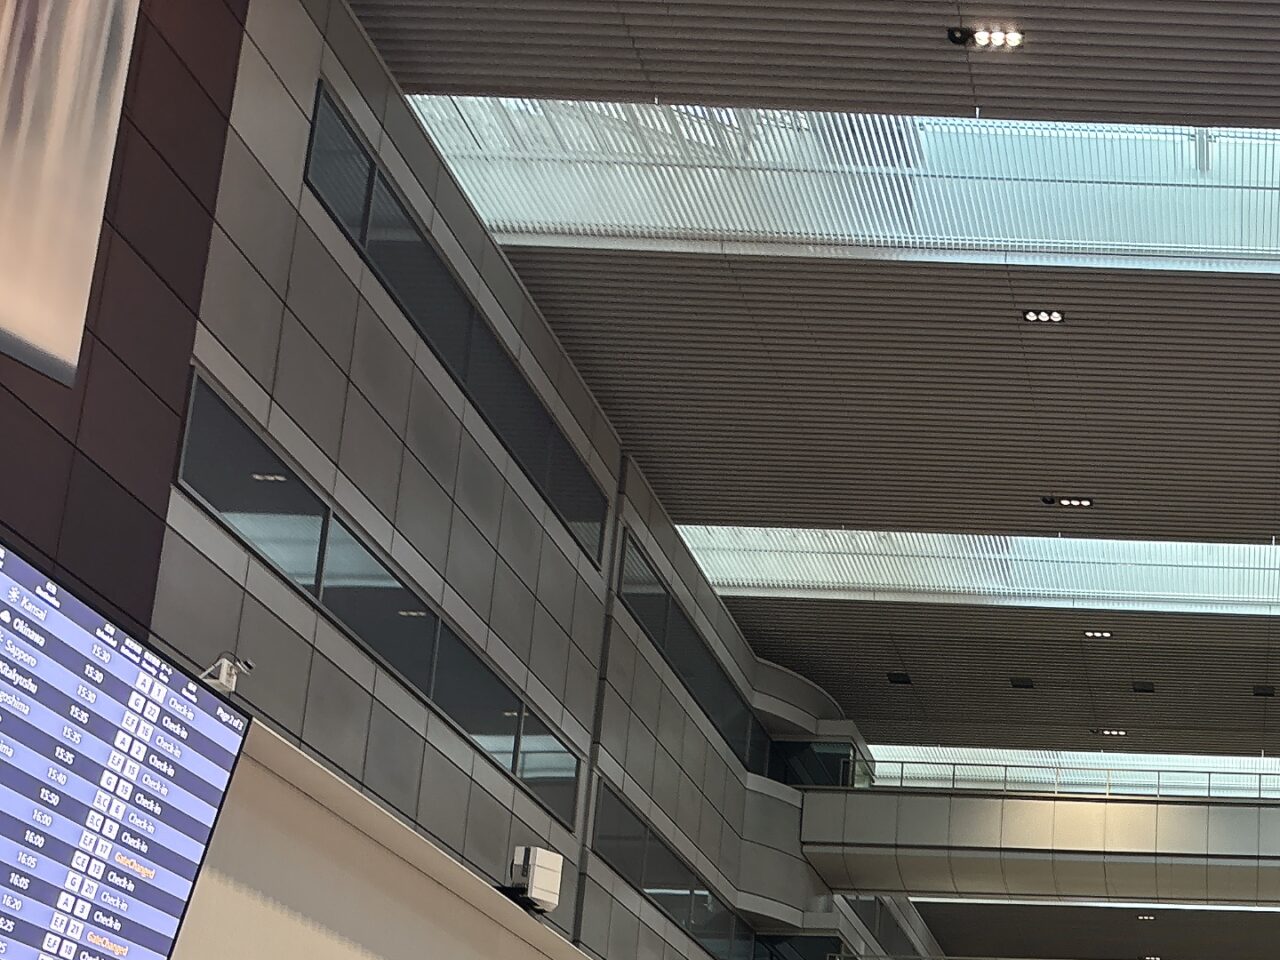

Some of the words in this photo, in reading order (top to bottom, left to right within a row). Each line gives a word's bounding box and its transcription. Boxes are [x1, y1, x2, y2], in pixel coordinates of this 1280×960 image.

[21, 596, 47, 620] Kansai
[169, 698, 194, 720] Check-in
[14, 619, 45, 647] Okinawa
[163, 717, 187, 738] Check-in
[5, 640, 37, 667] Sapporo
[156, 736, 181, 758] Check-in
[150, 755, 174, 776] Check-in
[143, 774, 168, 795] Check-in
[136, 794, 161, 814] Check-in
[129, 813, 154, 833] Check-in
[122, 832, 148, 852] Check-in
[108, 872, 134, 891] Check-in
[102, 892, 128, 911] Check-in
[94, 912, 121, 930] Check-in
